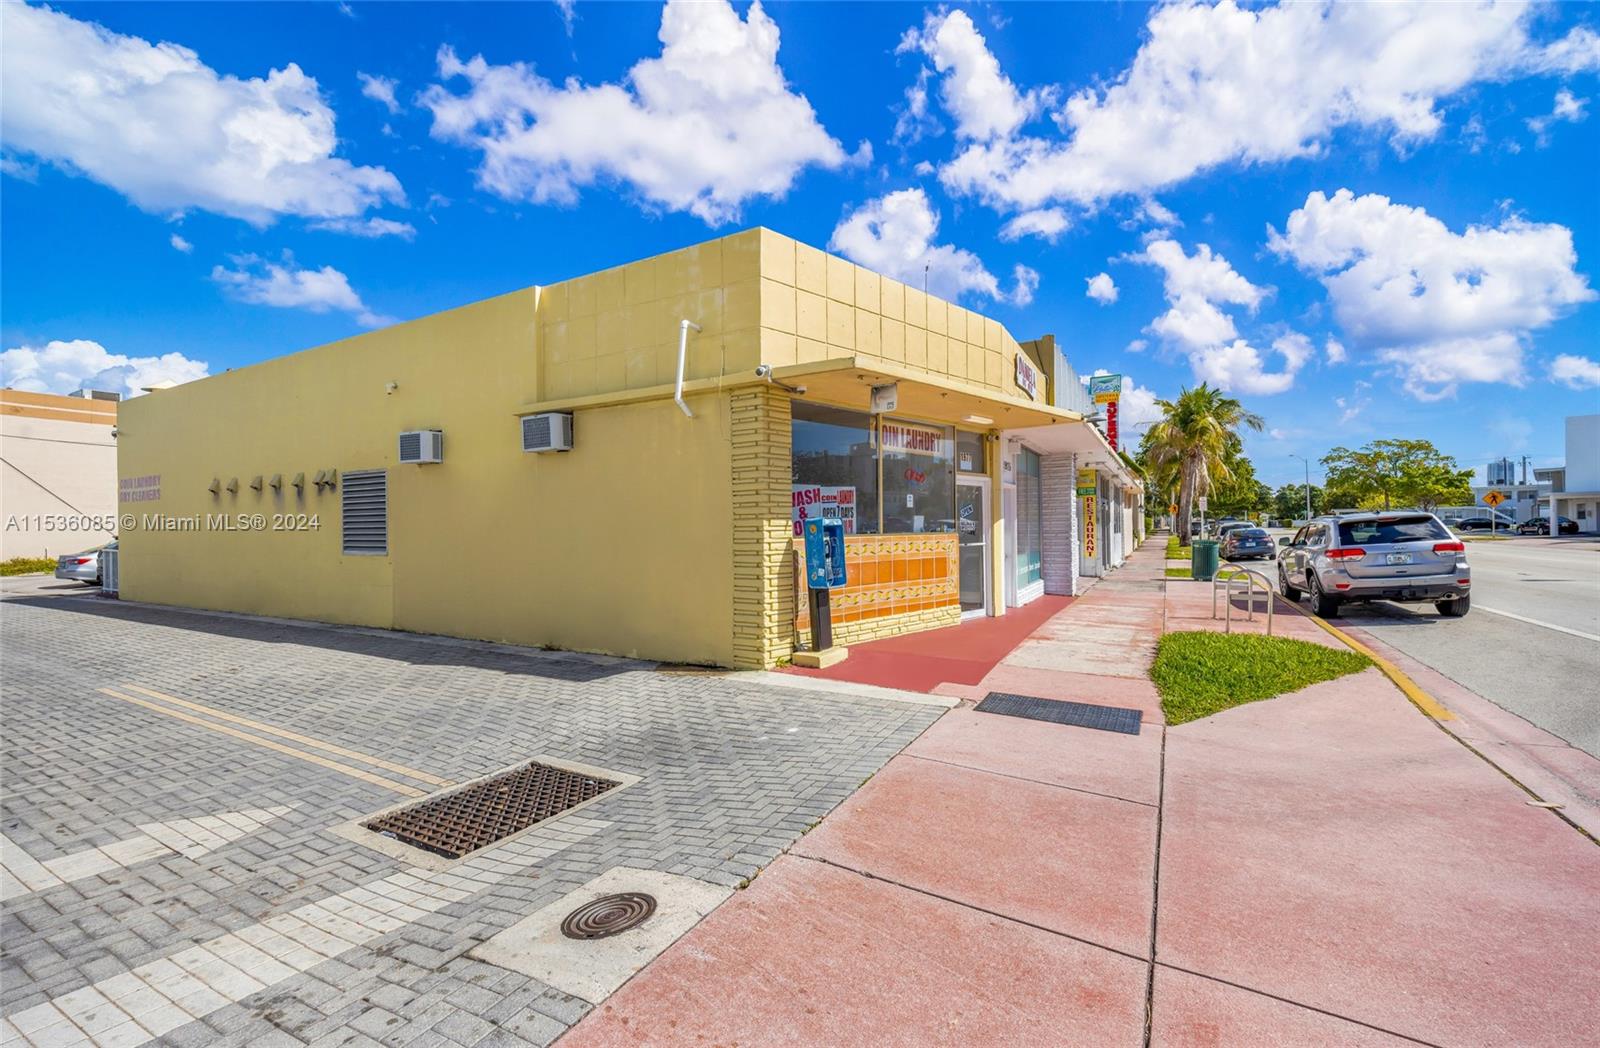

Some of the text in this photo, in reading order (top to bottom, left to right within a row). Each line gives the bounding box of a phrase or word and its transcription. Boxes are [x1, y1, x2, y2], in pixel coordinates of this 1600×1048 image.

[900, 427, 941, 453] LAUNDRY
[134, 474, 161, 488] LAUNDRY
[799, 506, 808, 519] &
[1086, 496, 1094, 557] RESTAURANT
